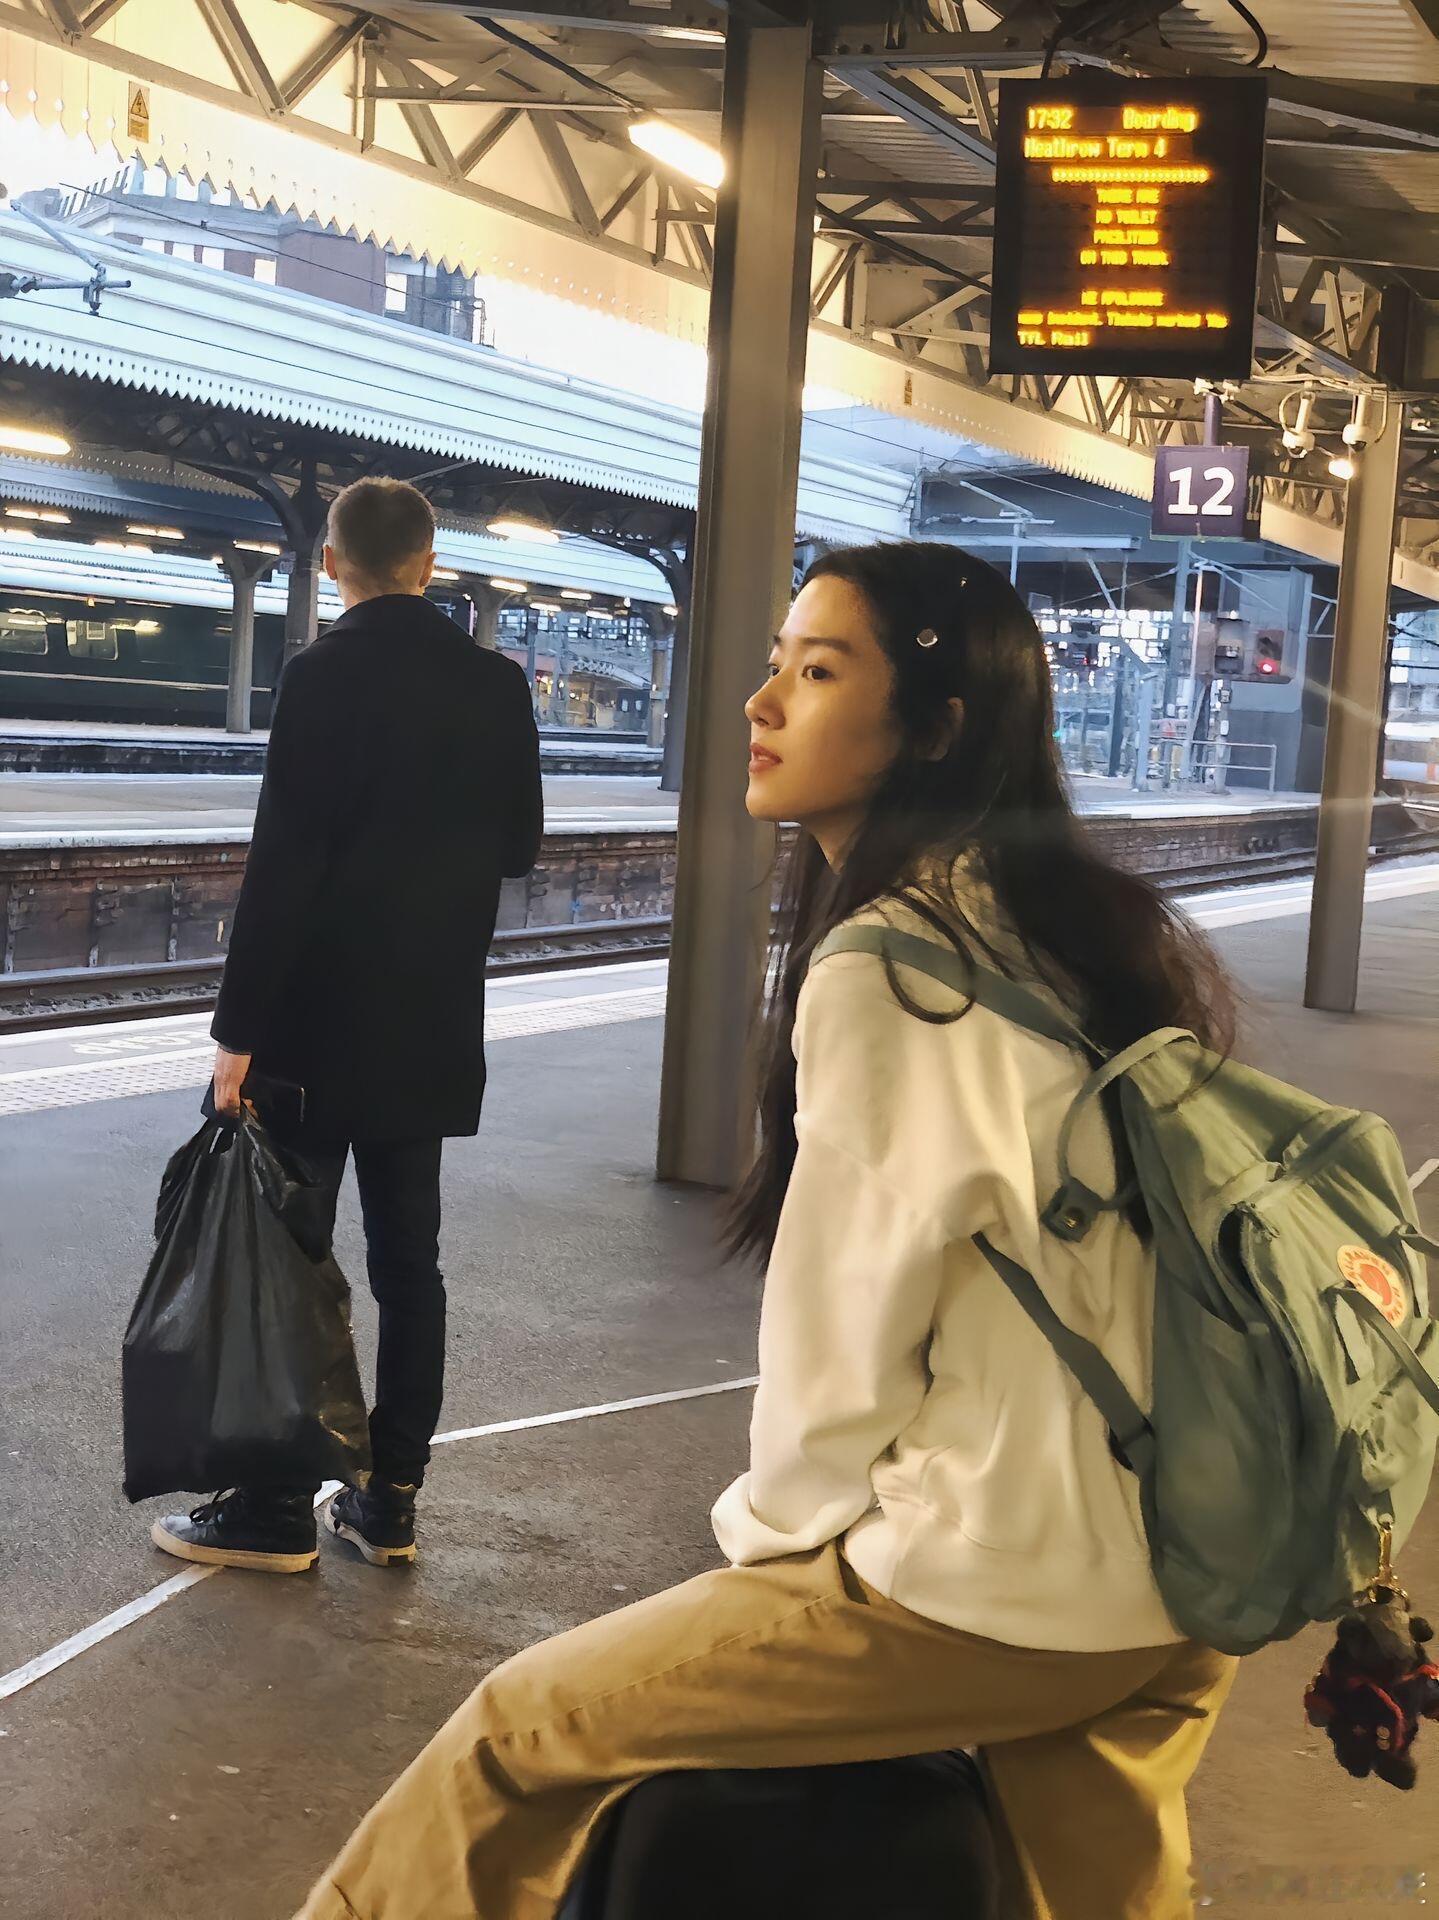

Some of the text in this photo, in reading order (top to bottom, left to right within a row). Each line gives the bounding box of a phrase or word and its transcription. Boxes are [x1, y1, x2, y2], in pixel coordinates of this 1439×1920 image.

[1123, 107, 1197, 132] Boarding
[1024, 136, 1167, 158] Heathrow Term 4
[1116, 209, 1158, 224] TOILET
[1051, 330, 1089, 346] Rail
[1168, 466, 1235, 516] 12
